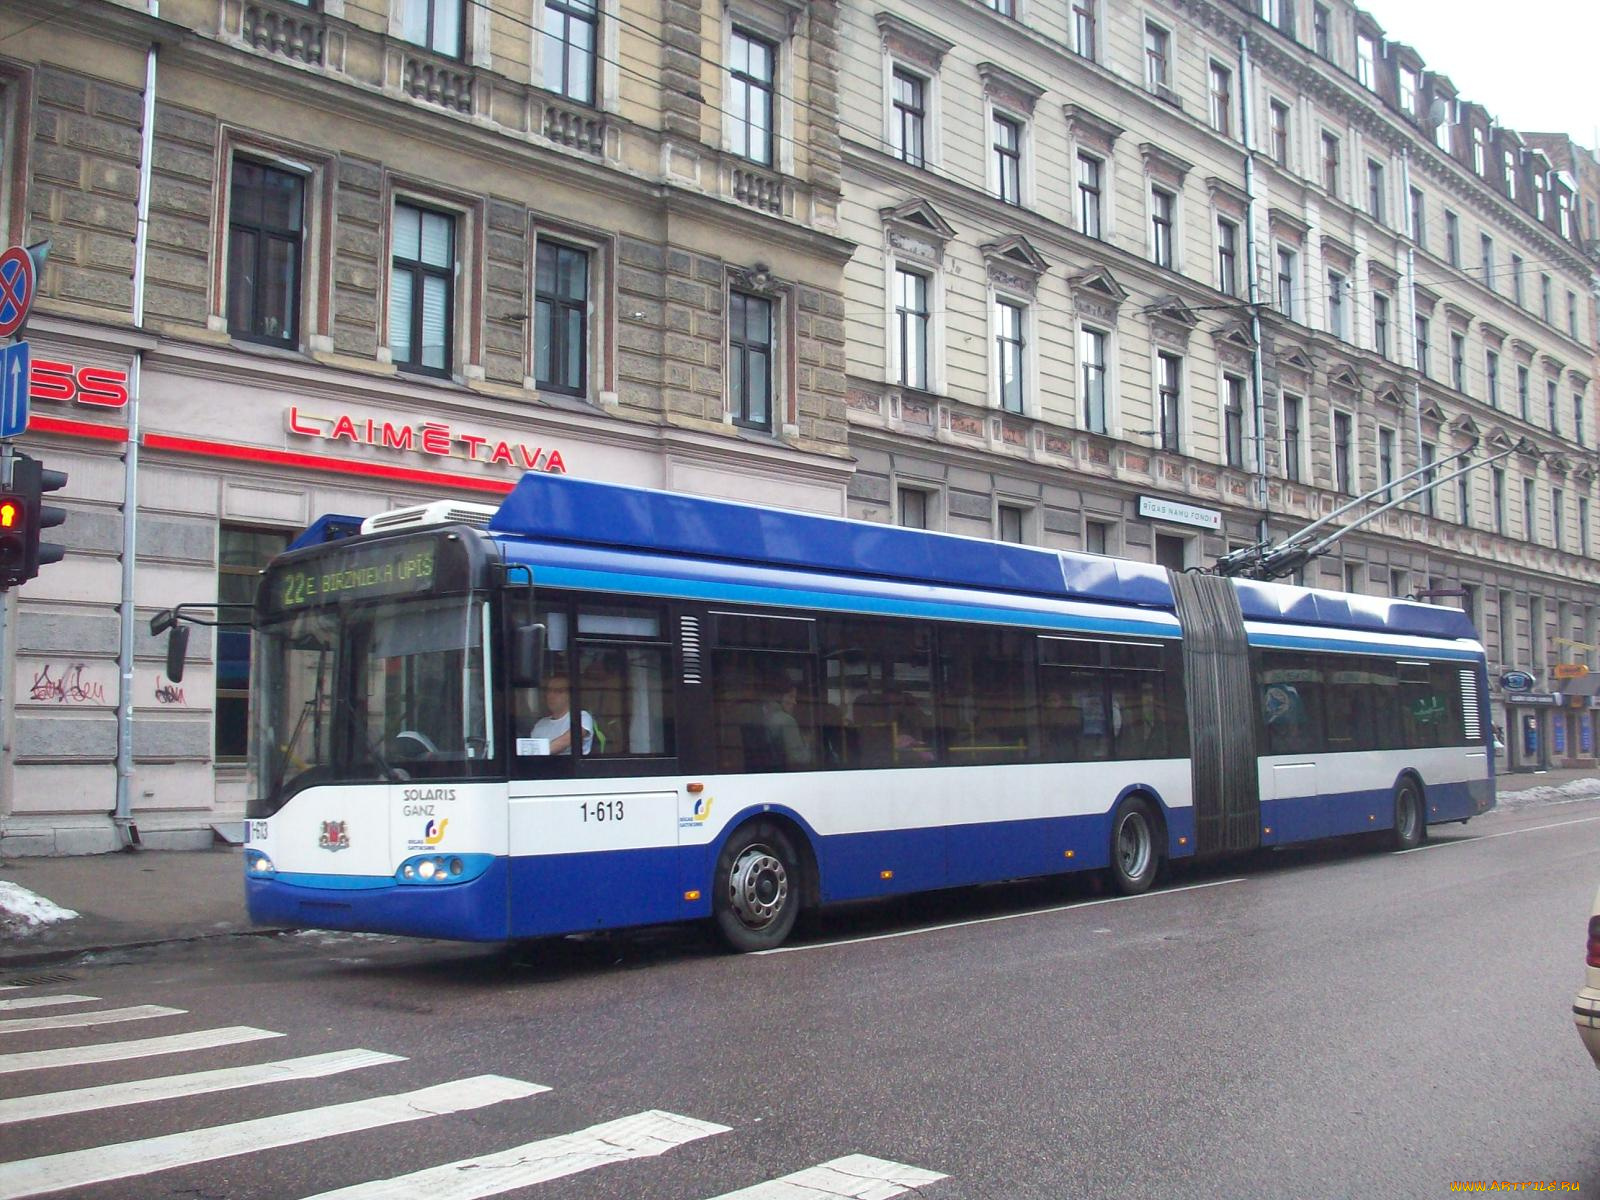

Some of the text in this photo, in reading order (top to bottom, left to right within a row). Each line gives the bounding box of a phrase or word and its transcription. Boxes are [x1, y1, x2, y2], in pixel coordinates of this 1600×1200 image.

[290, 406, 567, 473] LAIMĒTAVA
[284, 572, 305, 605] 22
[403, 788, 456, 801] SOLARIS
[403, 804, 435, 816] GANZ
[580, 800, 624, 822] 1-613
